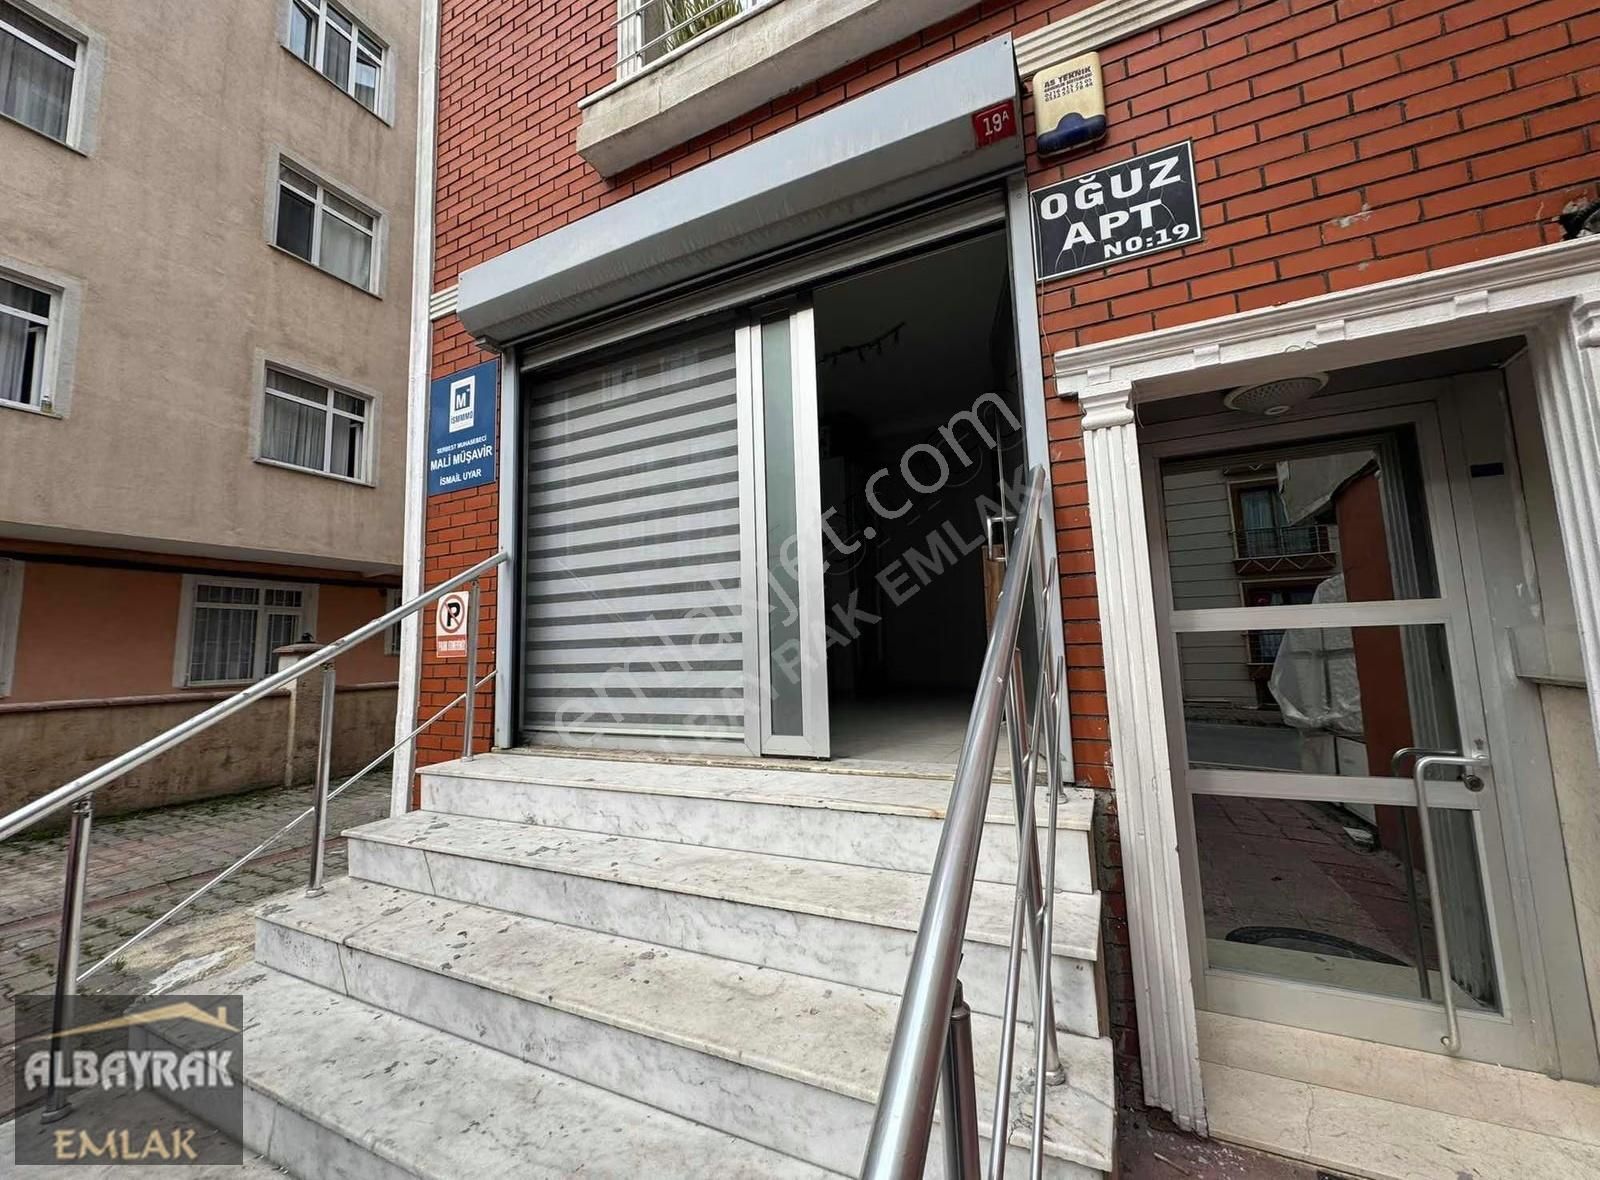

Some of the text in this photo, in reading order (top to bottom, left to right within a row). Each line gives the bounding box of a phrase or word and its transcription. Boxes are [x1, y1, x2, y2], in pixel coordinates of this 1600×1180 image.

[1040, 156, 1181, 220] OĞUZ
[1062, 199, 1161, 250] APT
[1103, 223, 1190, 258] NO:19
[431, 444, 493, 471] MALİ MÜŞAVİR
[462, 468, 482, 481] UYAR
